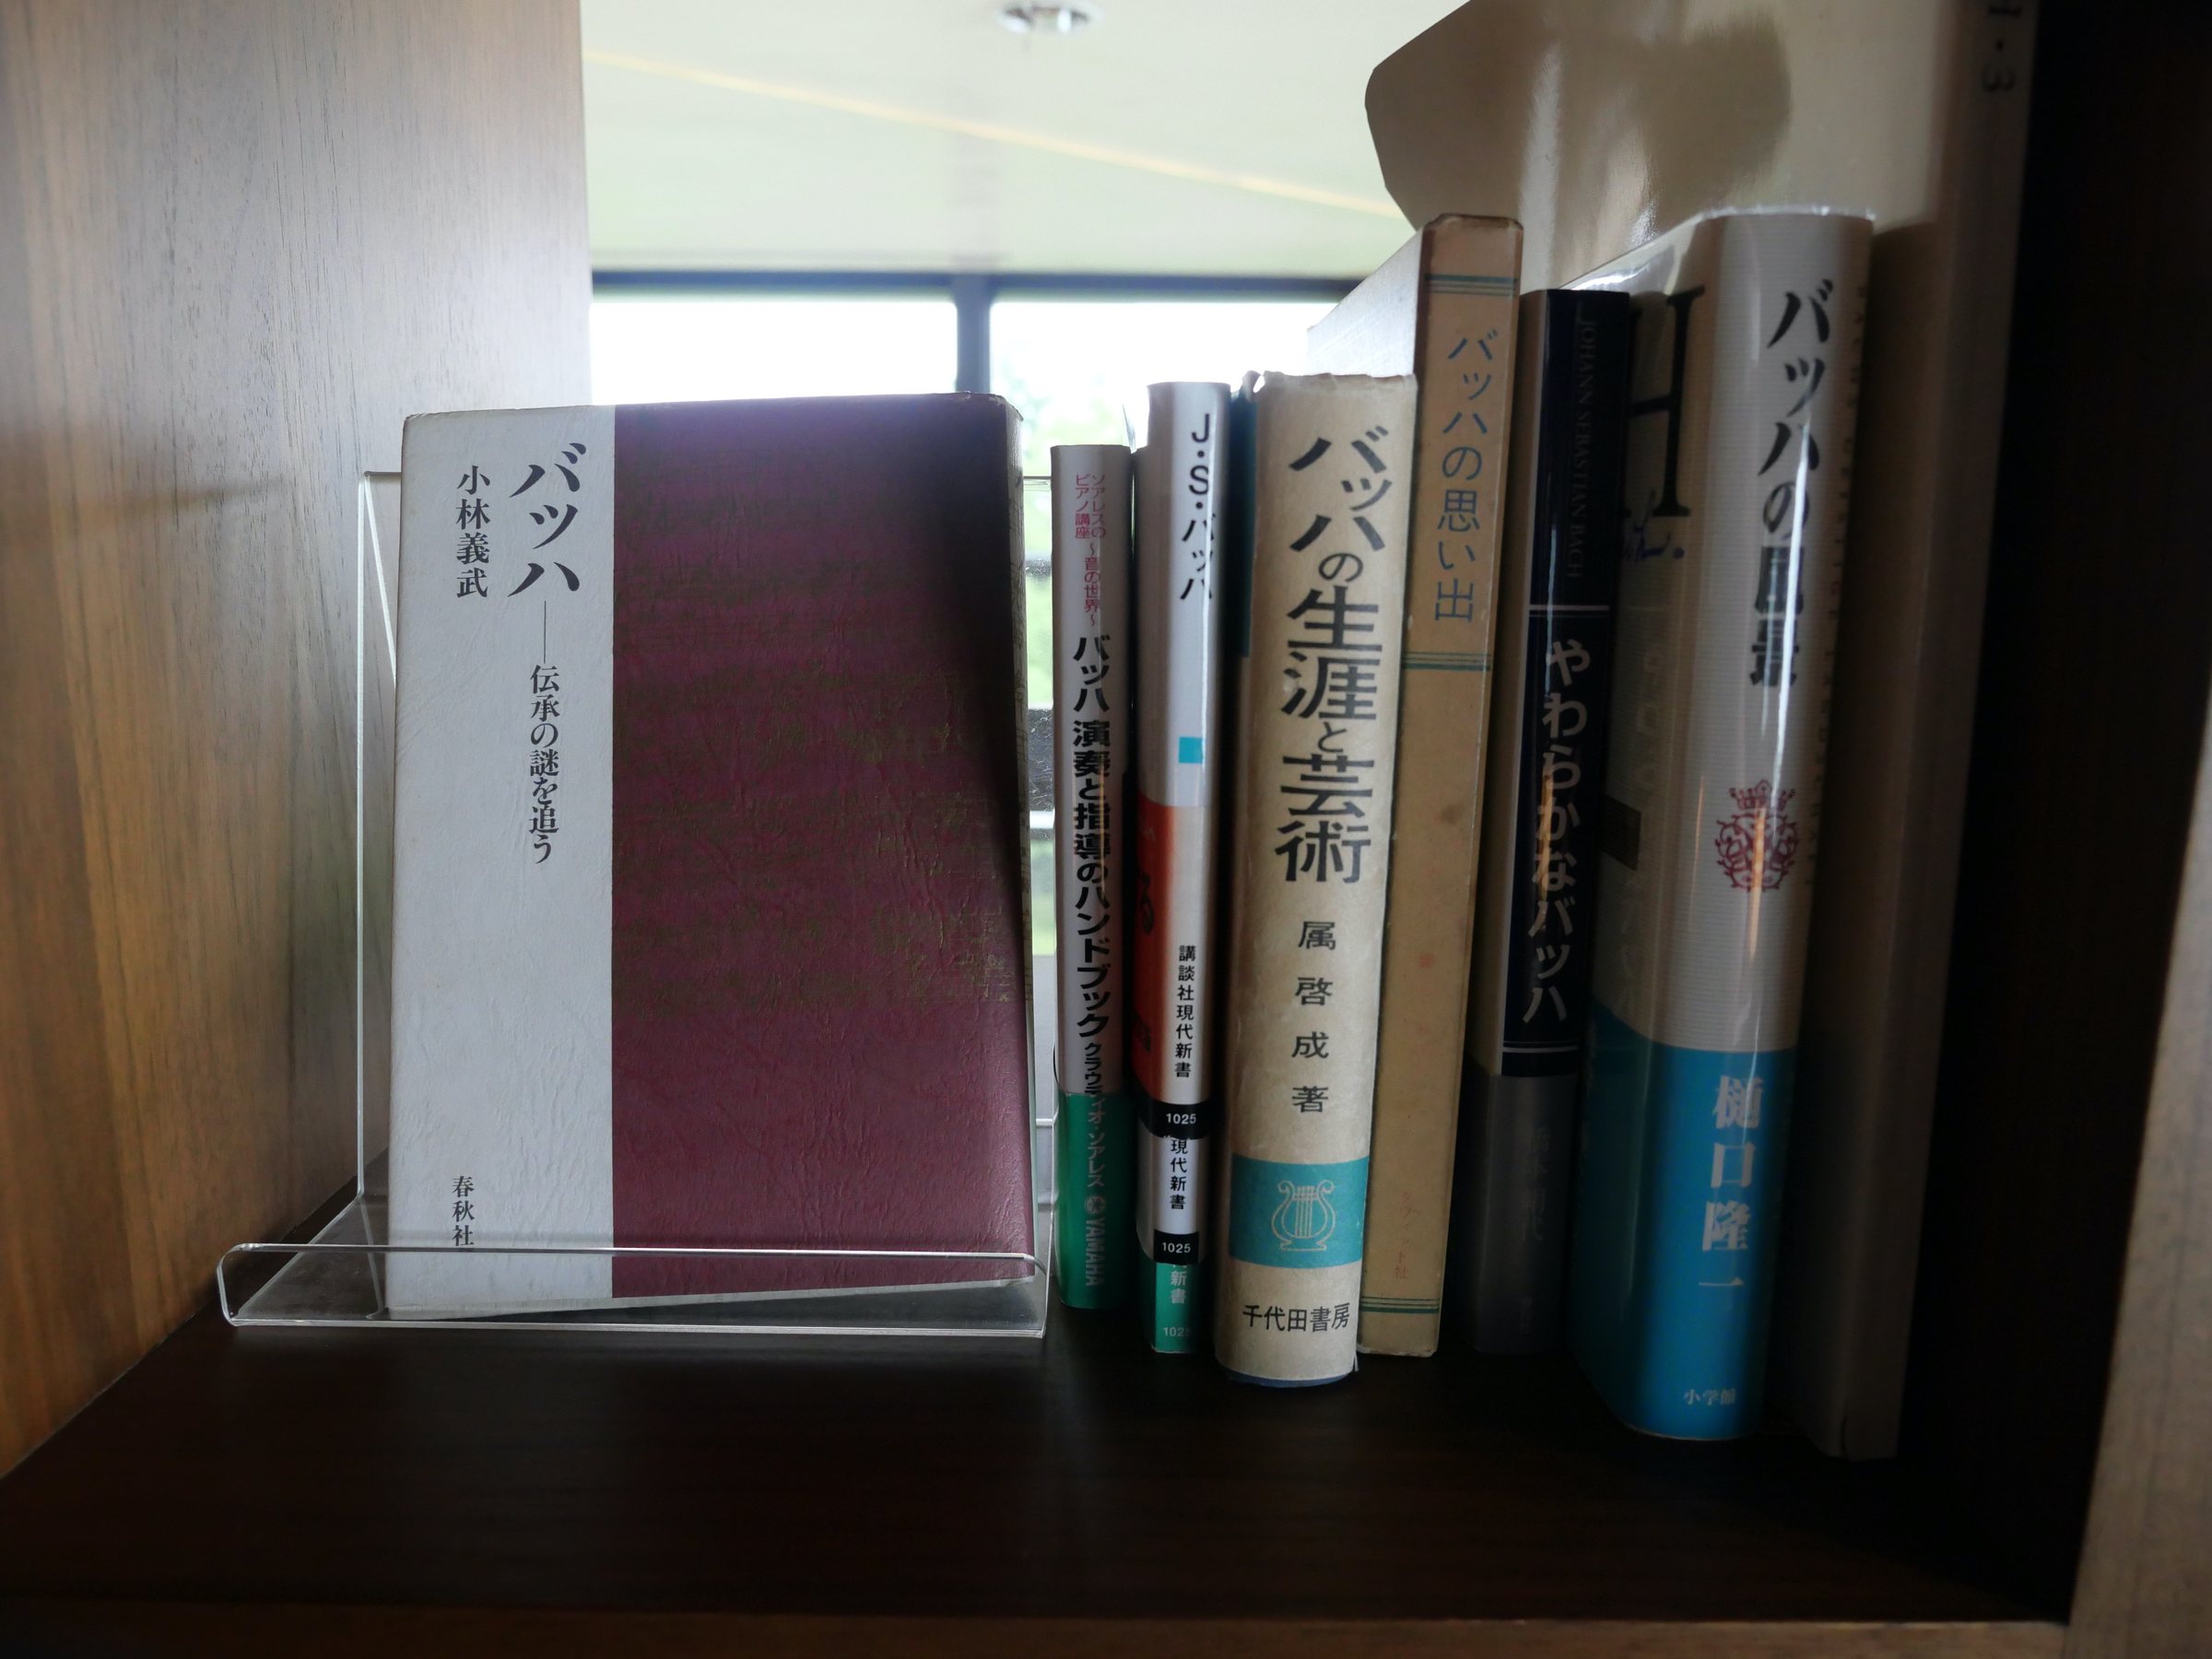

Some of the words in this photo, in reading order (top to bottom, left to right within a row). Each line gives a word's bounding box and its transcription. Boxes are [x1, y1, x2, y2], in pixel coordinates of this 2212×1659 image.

[1075, 474, 1091, 539] ピアノ講座
[1091, 474, 1106, 539] ソアレスの
[1434, 328, 1500, 622] バッハの思い出
[455, 465, 491, 599] 小林義武
[508, 442, 587, 598] バッハ
[1275, 425, 1393, 885] バッハの生涯と芸術
[528, 665, 561, 865] 伝承の謎を追う
[1522, 638, 1591, 1024] やわらかなバッハ
[1174, 945, 1196, 1078] 講談社現代新書
[1165, 1112, 1197, 1124] 1025
[1169, 1137, 1189, 1210] 現代新書
[452, 1175, 476, 1247] 春秋社
[1161, 1241, 1192, 1253] 1025
[1085, 1215, 1106, 1287] YAMAHA
[1241, 1302, 1351, 1334] 千代田書房
